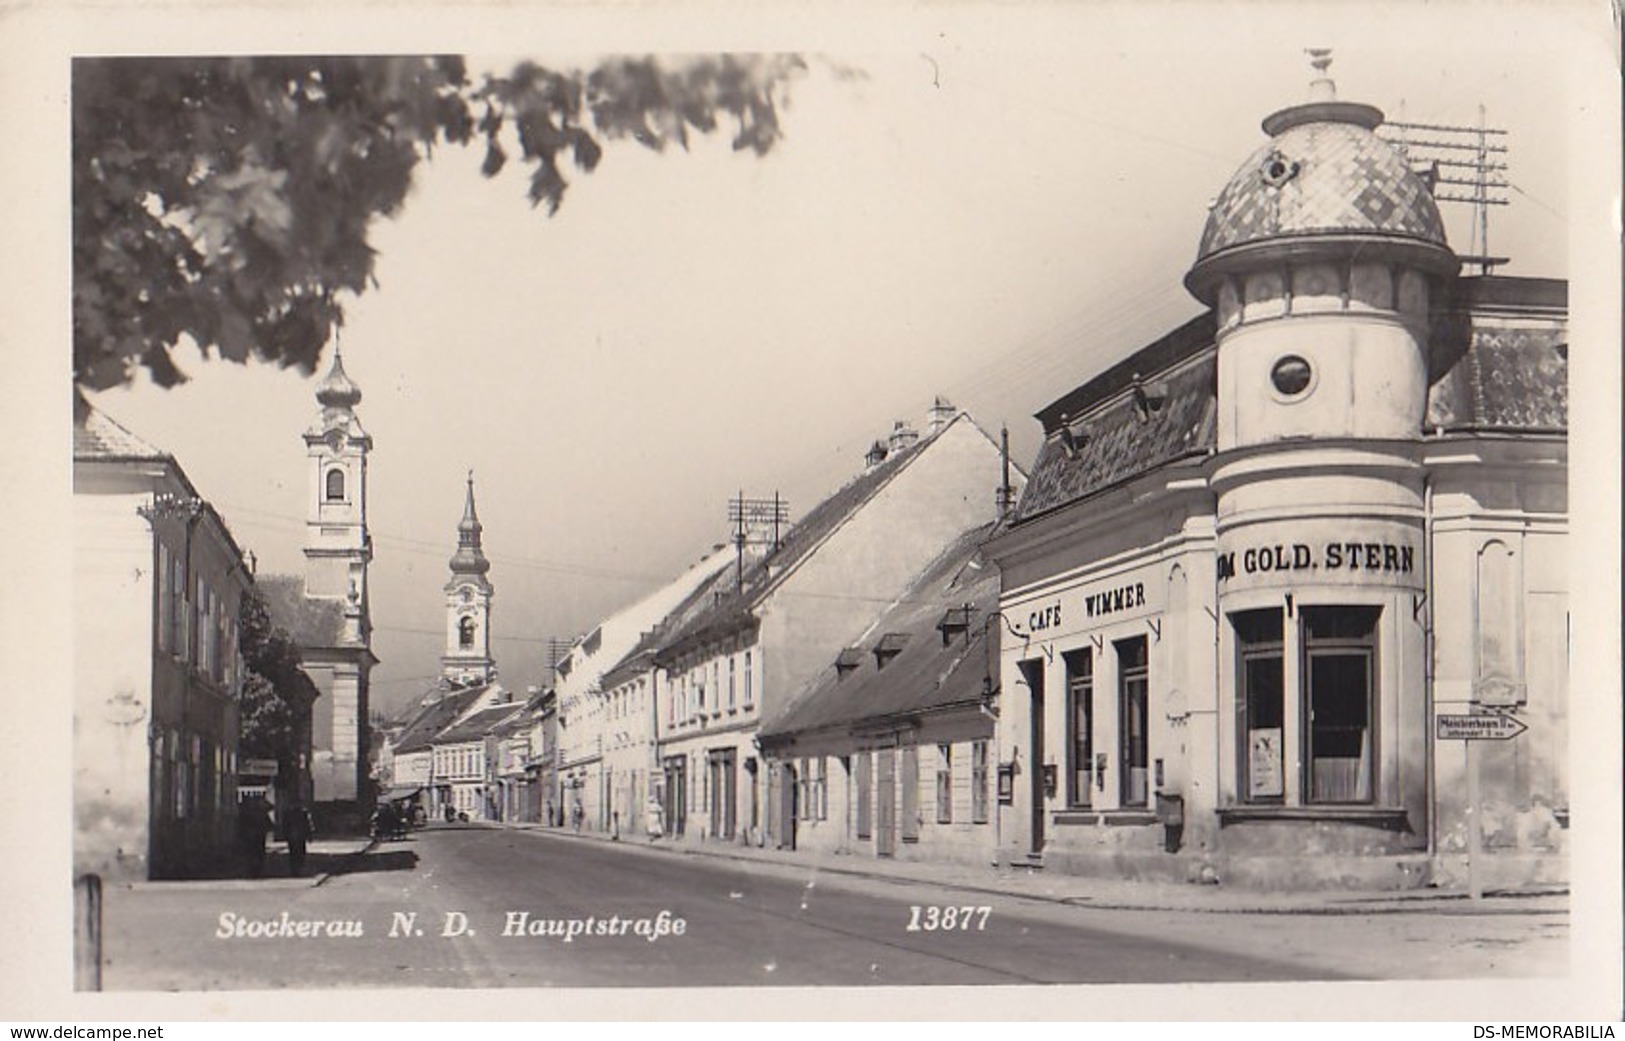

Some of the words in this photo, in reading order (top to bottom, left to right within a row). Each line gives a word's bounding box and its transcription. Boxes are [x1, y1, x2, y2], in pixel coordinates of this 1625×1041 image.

[1244, 545, 1319, 574] GOLD.
[1325, 543, 1414, 573] STERN
[1029, 599, 1061, 632] CAFÉ
[1085, 582, 1146, 617] WIMMER
